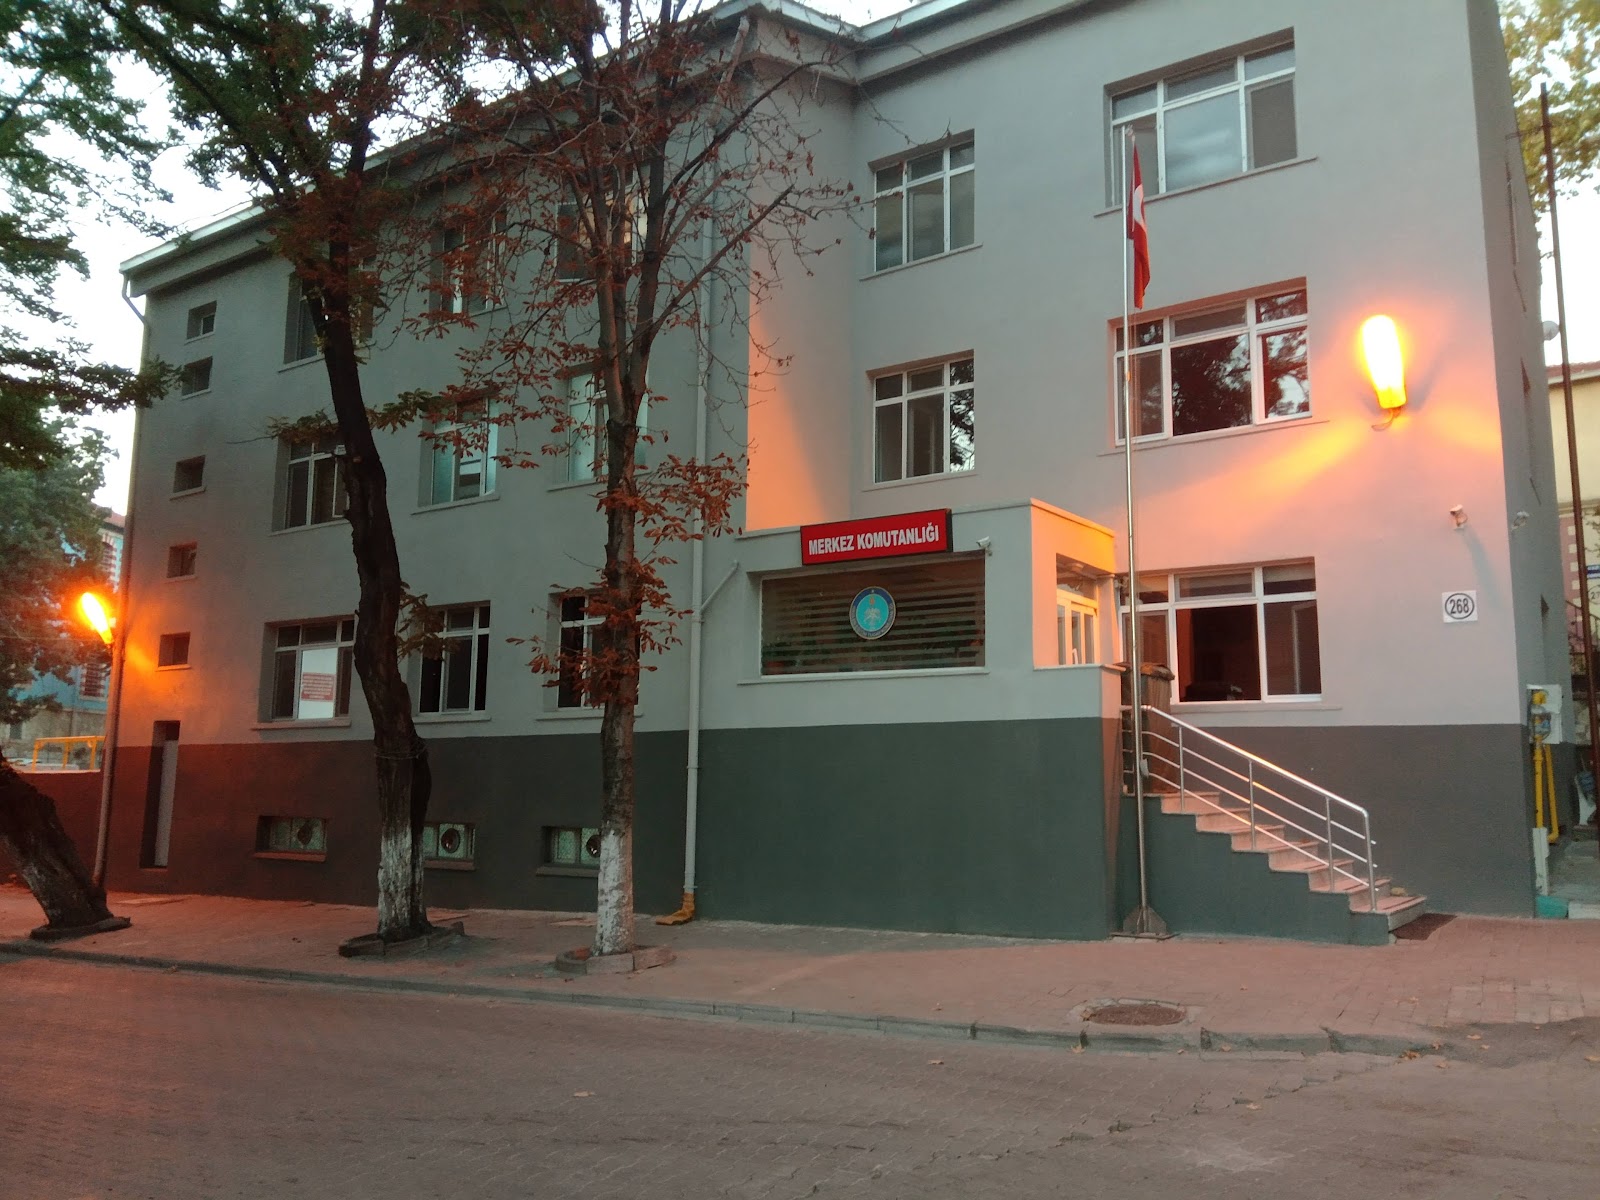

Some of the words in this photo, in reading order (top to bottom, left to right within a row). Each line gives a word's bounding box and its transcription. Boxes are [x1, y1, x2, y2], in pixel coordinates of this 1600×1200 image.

[809, 535, 854, 555] MERKEZ
[857, 522, 939, 550] KOMUTANLIĞI
[1450, 598, 1469, 614] 268
